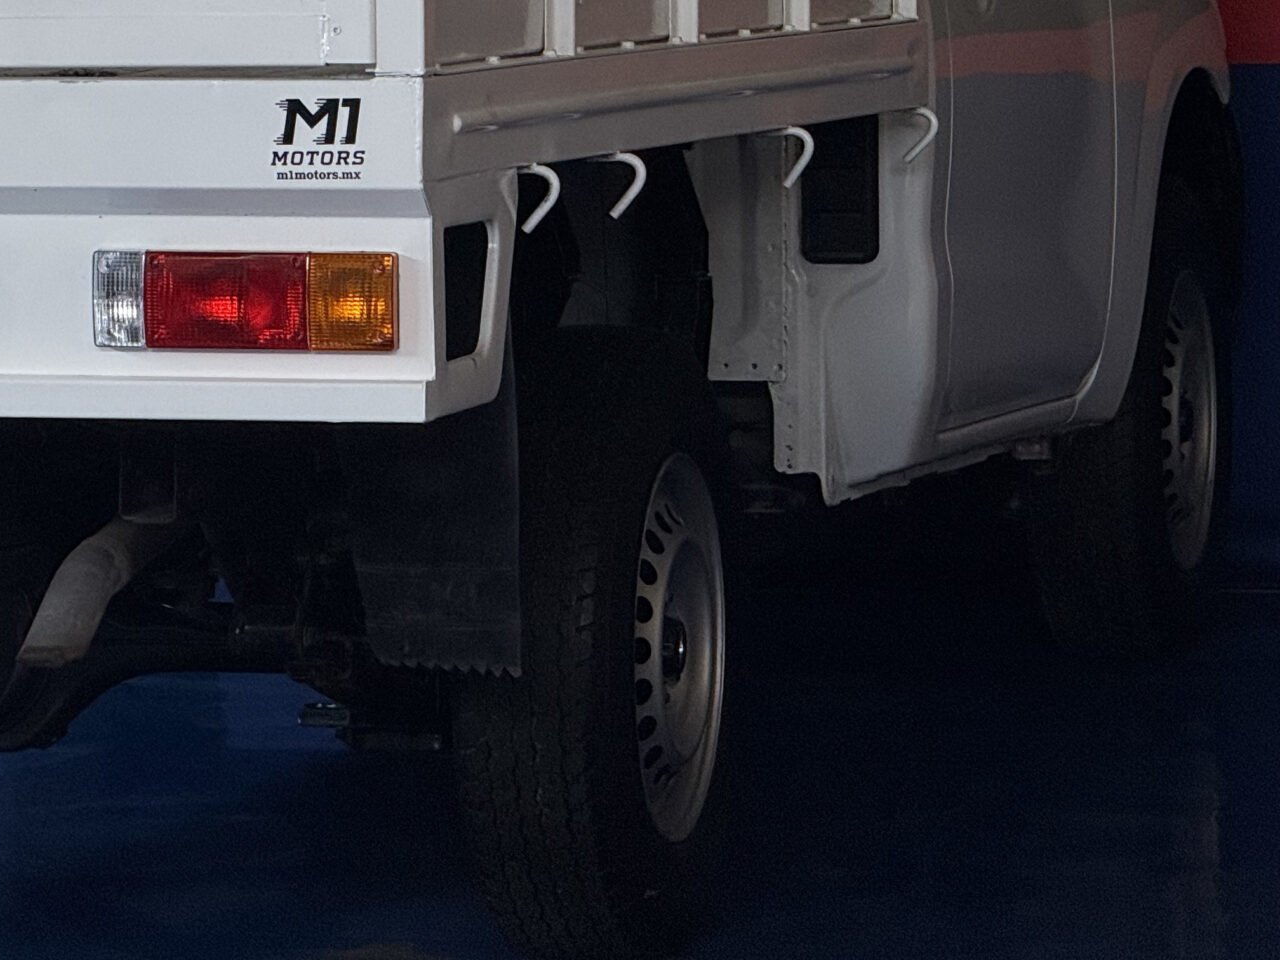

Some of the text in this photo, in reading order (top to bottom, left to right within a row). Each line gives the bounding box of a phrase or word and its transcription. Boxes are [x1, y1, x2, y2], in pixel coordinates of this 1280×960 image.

[273, 97, 362, 146] M1
[270, 150, 367, 167] MOTORS
[276, 170, 362, 181] m1motors.mx
